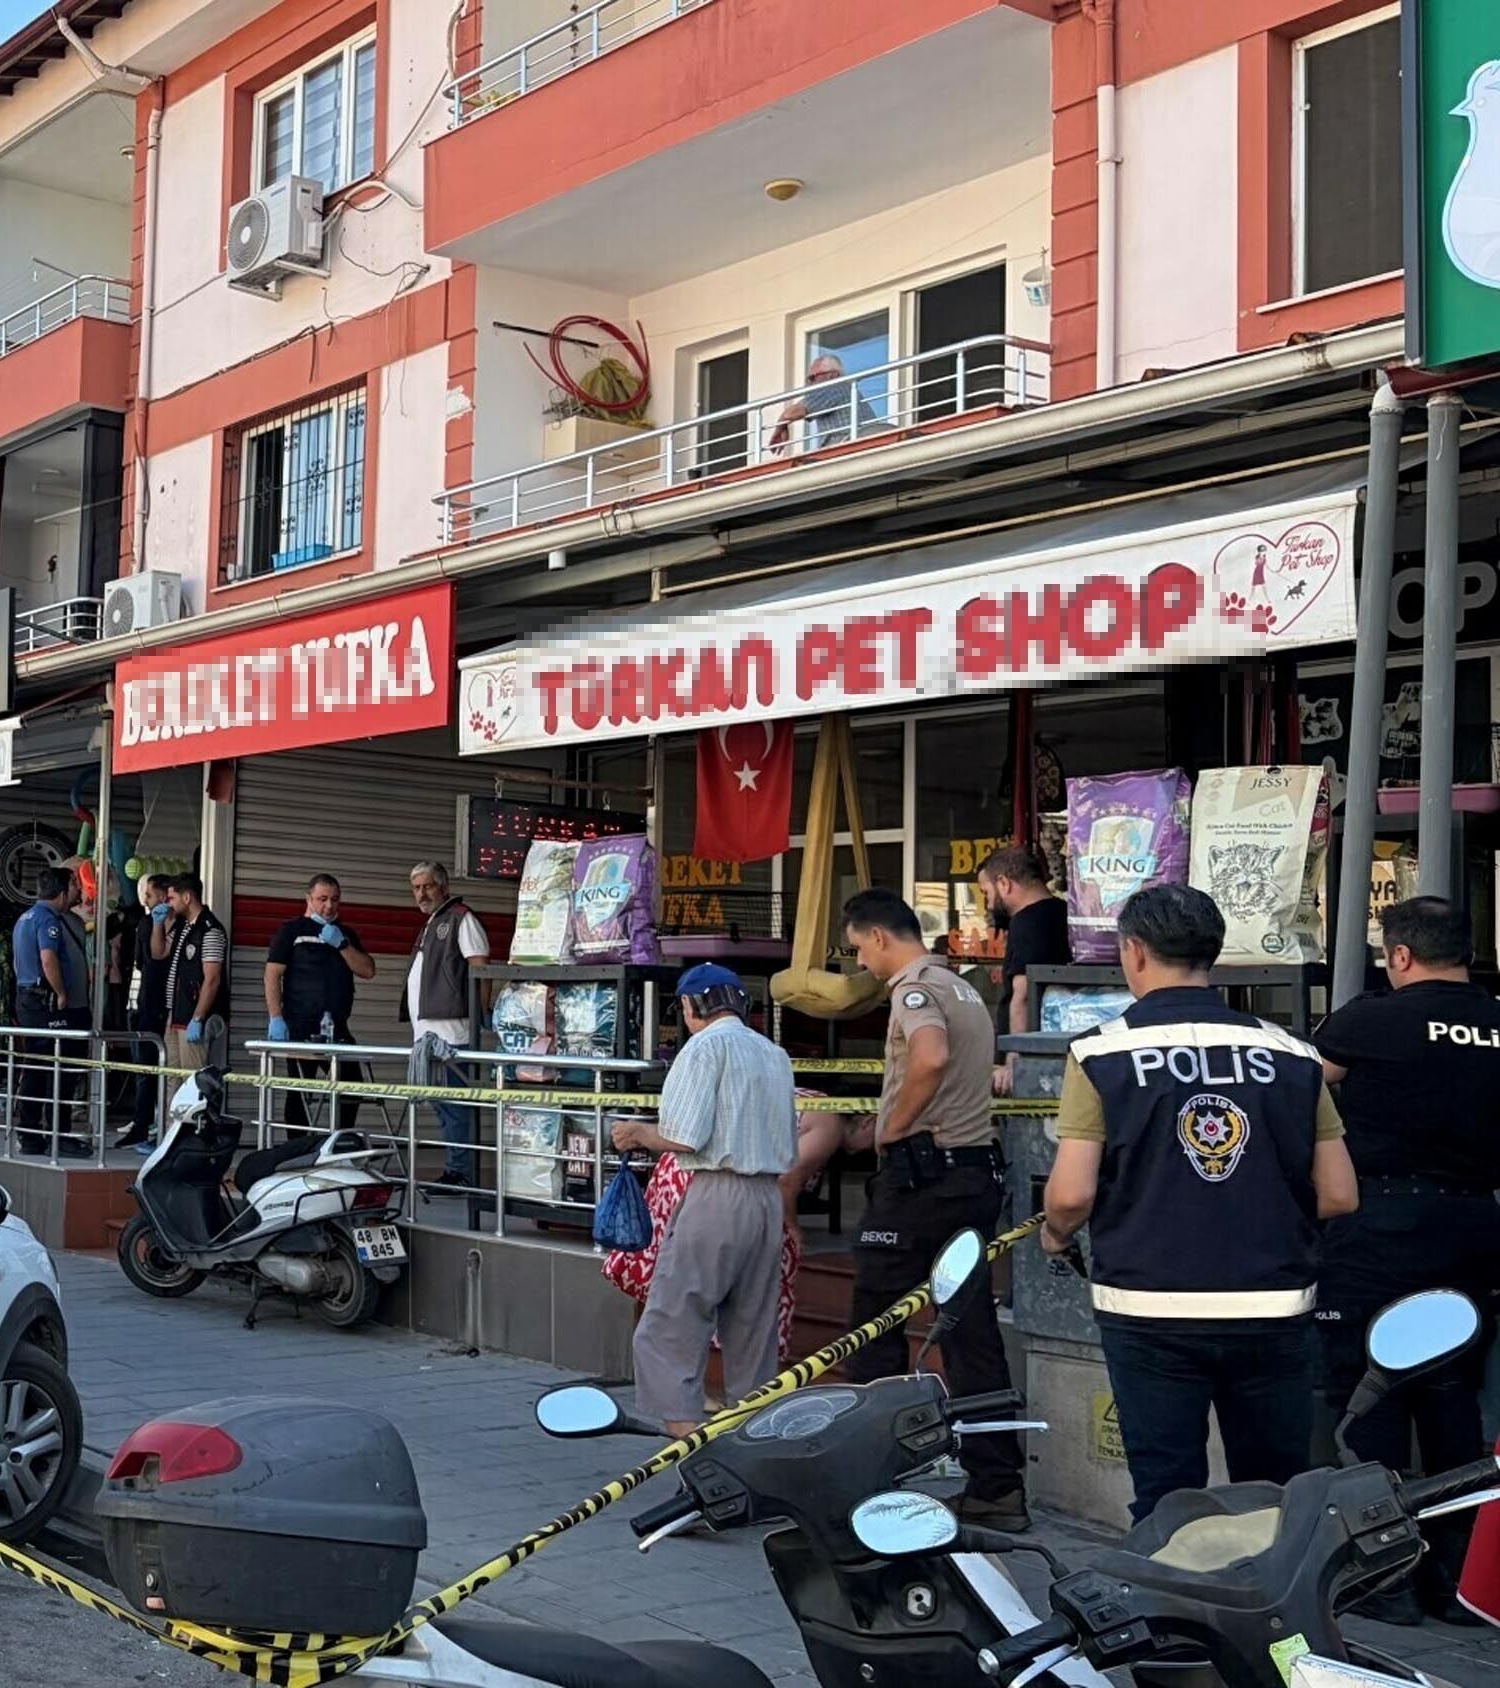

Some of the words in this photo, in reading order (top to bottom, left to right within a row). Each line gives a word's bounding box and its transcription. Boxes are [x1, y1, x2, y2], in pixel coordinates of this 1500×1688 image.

[956, 562, 1205, 680] SHOP
[1250, 777, 1293, 791] JESSY
[1090, 856, 1147, 874] KING
[580, 886, 621, 903] KING
[357, 1229, 373, 1244] 48
[372, 1243, 395, 1258] 845
